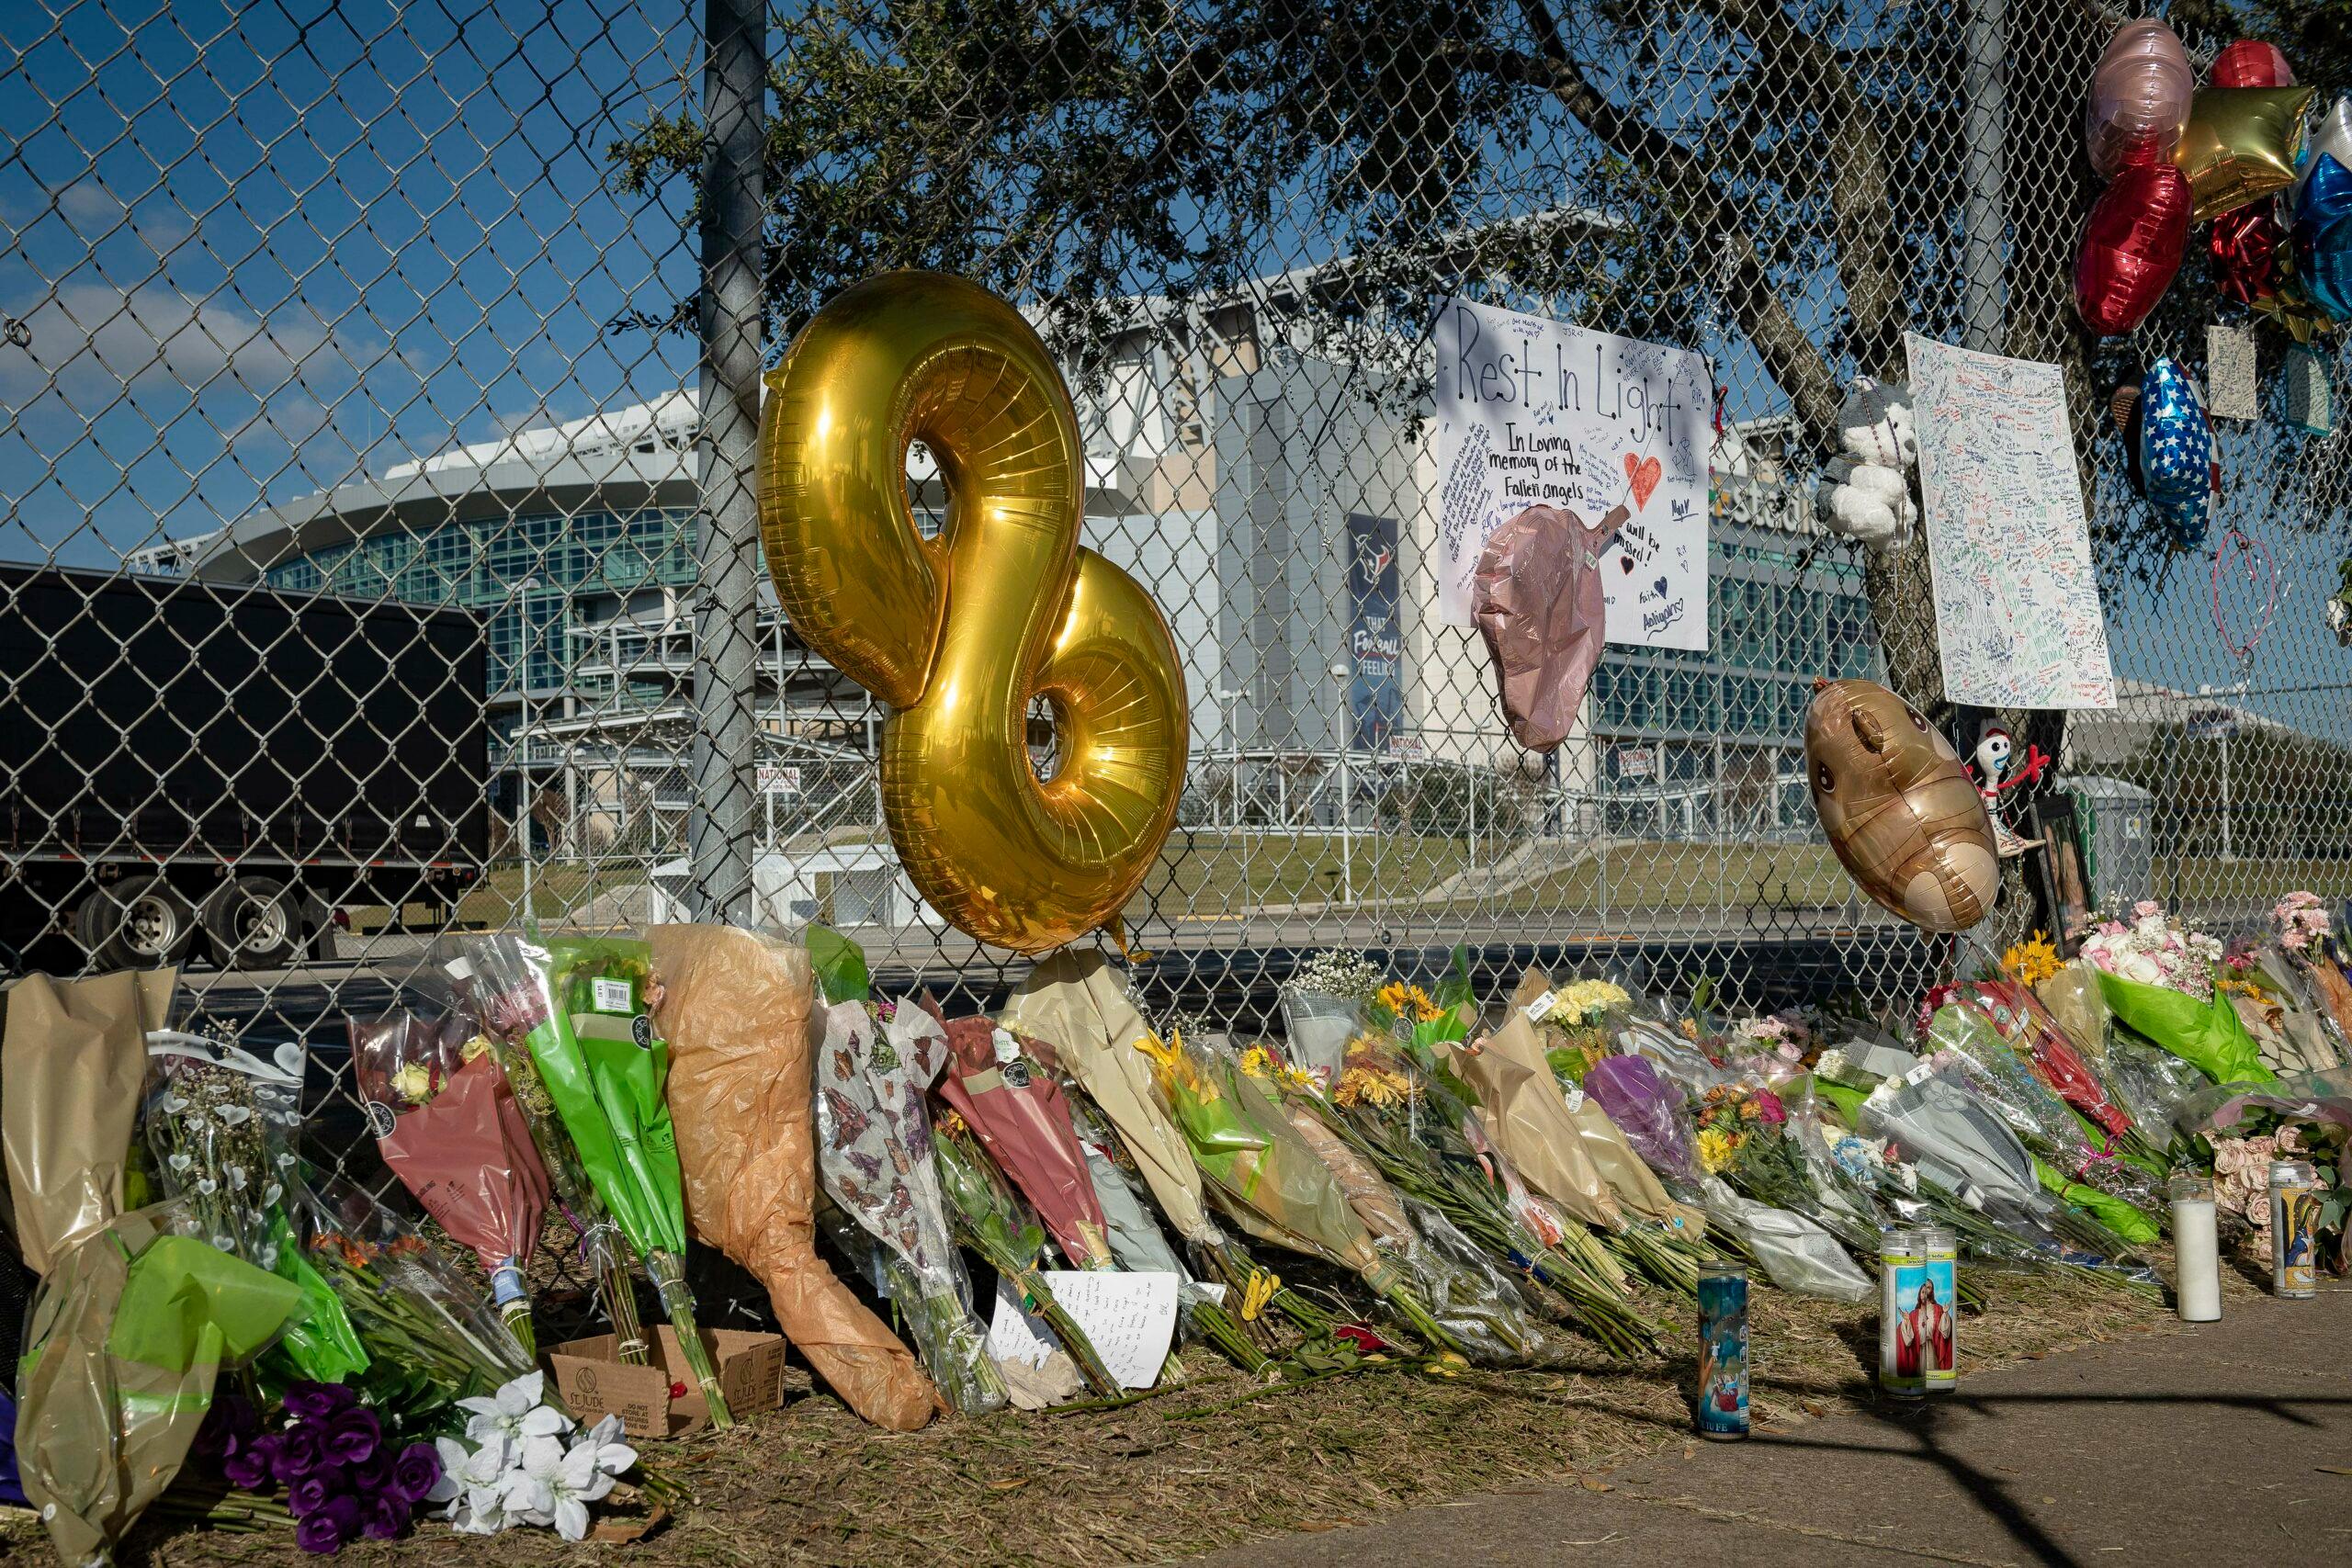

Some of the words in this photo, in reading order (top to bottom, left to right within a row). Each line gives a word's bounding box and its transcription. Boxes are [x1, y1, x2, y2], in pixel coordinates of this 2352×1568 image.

[1456, 305, 1543, 408] Rest
[1556, 344, 1581, 412] In
[1596, 344, 1682, 447] Light
[1505, 422, 1525, 453] In
[1529, 432, 1574, 466] Loving
[1489, 452, 1541, 479] memory
[1544, 457, 1559, 472] of
[1562, 457, 1582, 476] the
[1505, 476, 1541, 499] Fallen
[1543, 481, 1585, 506] angels
[1626, 522, 1645, 541] will
[1648, 533, 1660, 553] be
[1365, 615, 1386, 632] THAT
[1353, 629, 1399, 656] FOOBALL
[582, 1393, 605, 1409] JUDE
[1715, 1423, 1728, 1432] FE
